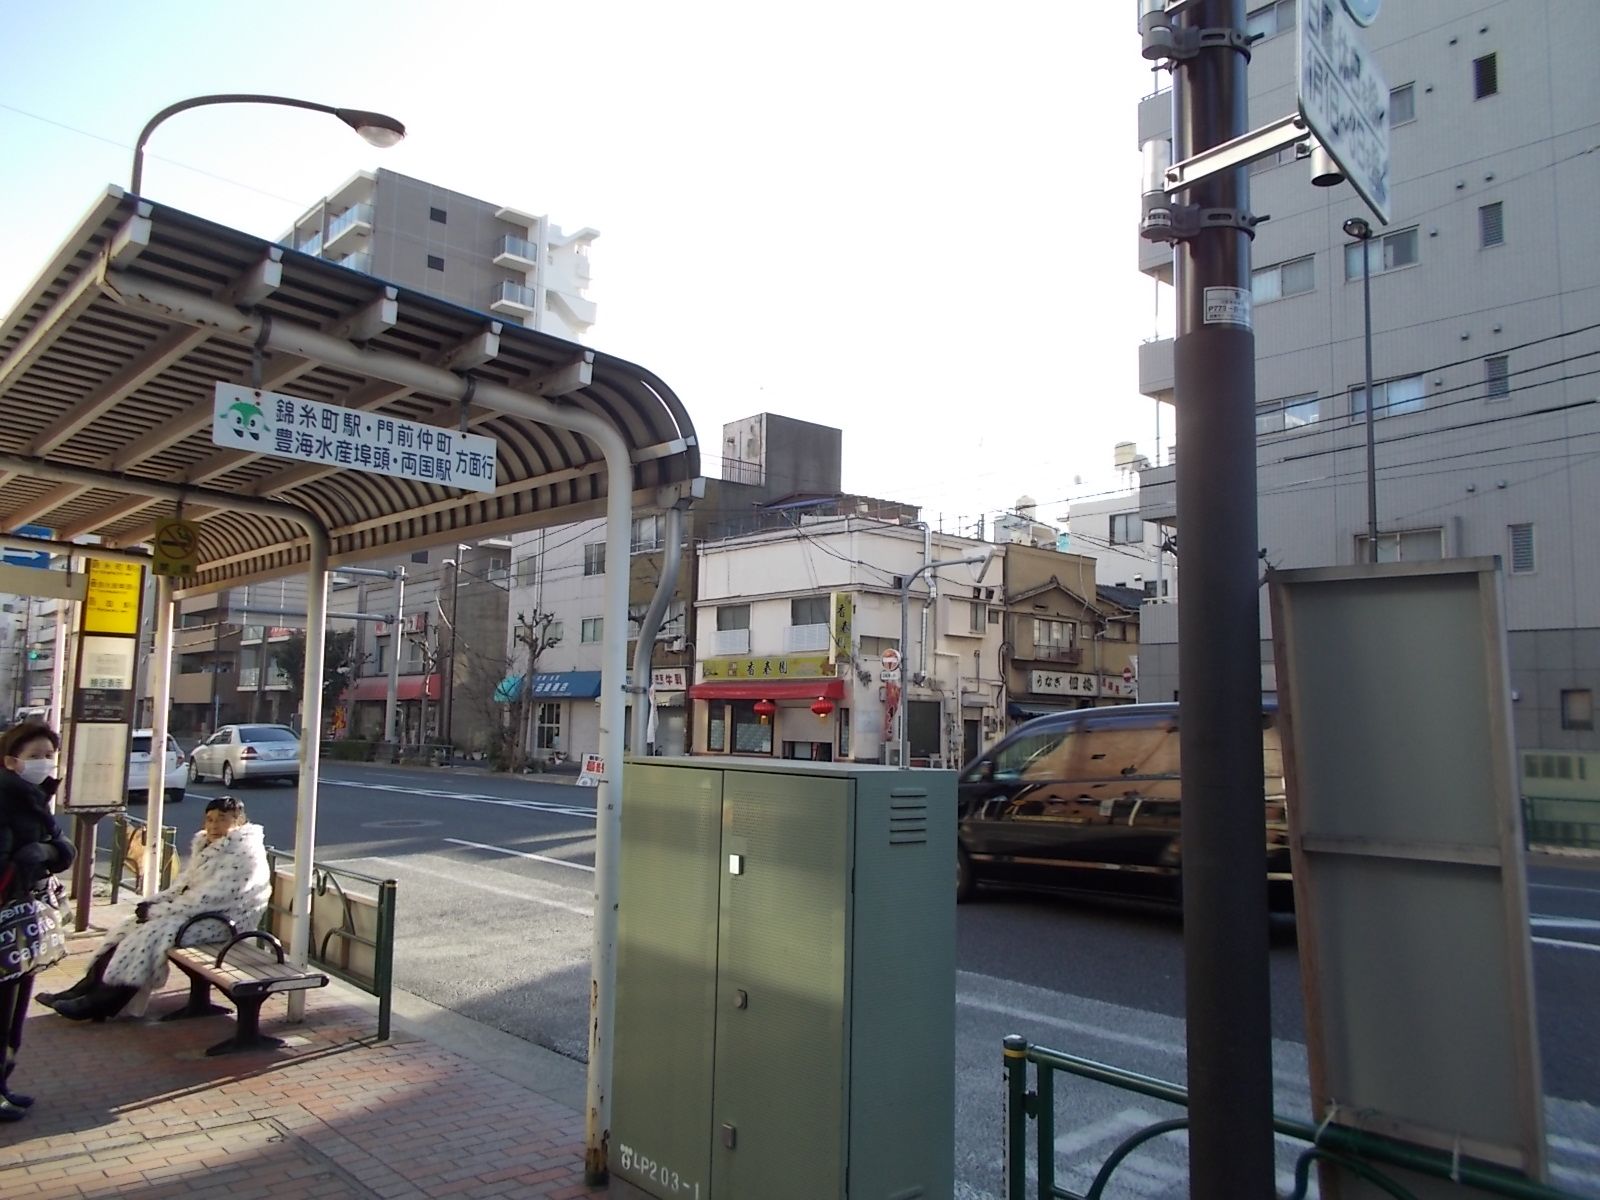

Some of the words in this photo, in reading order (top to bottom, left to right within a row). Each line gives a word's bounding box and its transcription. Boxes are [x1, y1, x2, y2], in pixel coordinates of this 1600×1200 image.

[275, 398, 453, 455] 錦糸町駅・門前仲町
[273, 427, 453, 482] 豊海水産埠頭・両国駅
[455, 449, 495, 481] 方面行
[1037, 674, 1063, 688] うなぎ
[9, 940, 48, 964] cafe
[633, 1151, 699, 1200] LP203-1
